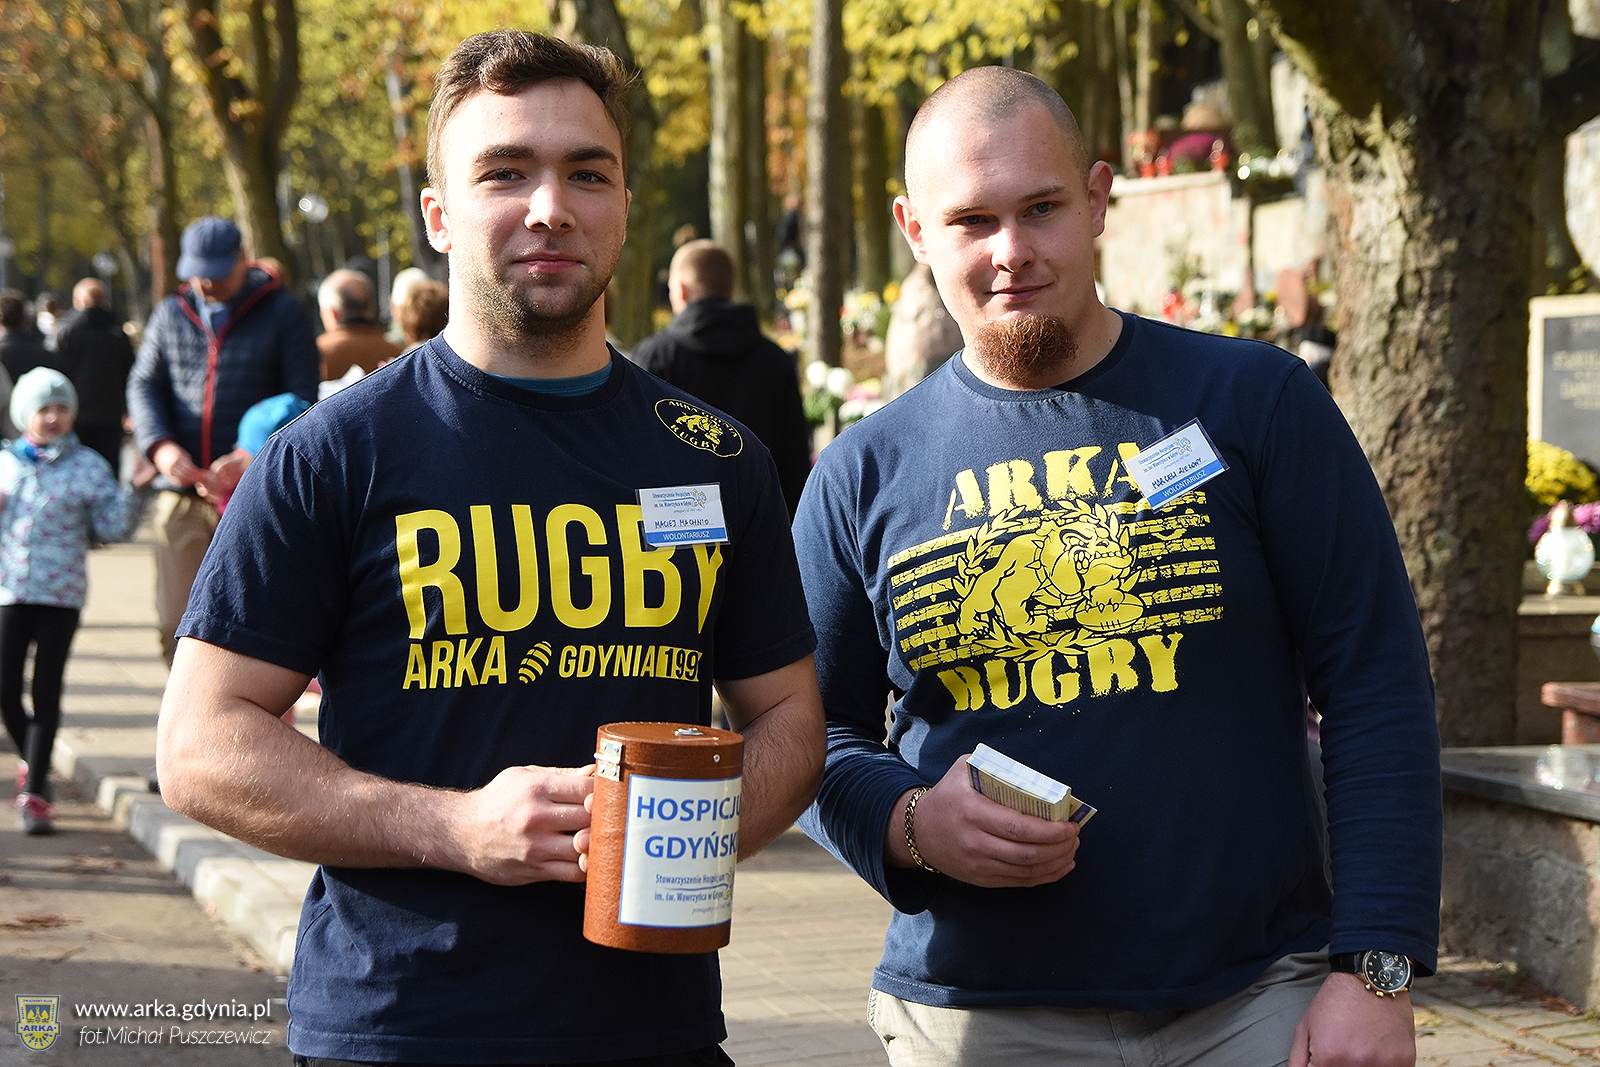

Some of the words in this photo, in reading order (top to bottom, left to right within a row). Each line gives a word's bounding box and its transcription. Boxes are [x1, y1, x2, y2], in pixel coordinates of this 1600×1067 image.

[670, 424, 718, 451] RUGBY
[942, 442, 1146, 530] ARKA
[1162, 470, 1207, 497] WOLONTARIUSZ
[654, 519, 677, 528] MACIEJ
[662, 531, 710, 541] WOLONTARIUSZ
[395, 503, 724, 639] RUGBY
[403, 636, 507, 690] ARKA
[559, 645, 655, 678] GDYNIA
[662, 647, 701, 681] 199
[937, 631, 1184, 712] RUGBY
[636, 792, 742, 822] HOSPICJU
[644, 831, 739, 860] GDYŃSK
[655, 873, 702, 886] Stowarzyszenie
[654, 891, 665, 901] im.
[665, 891, 676, 901] św.
